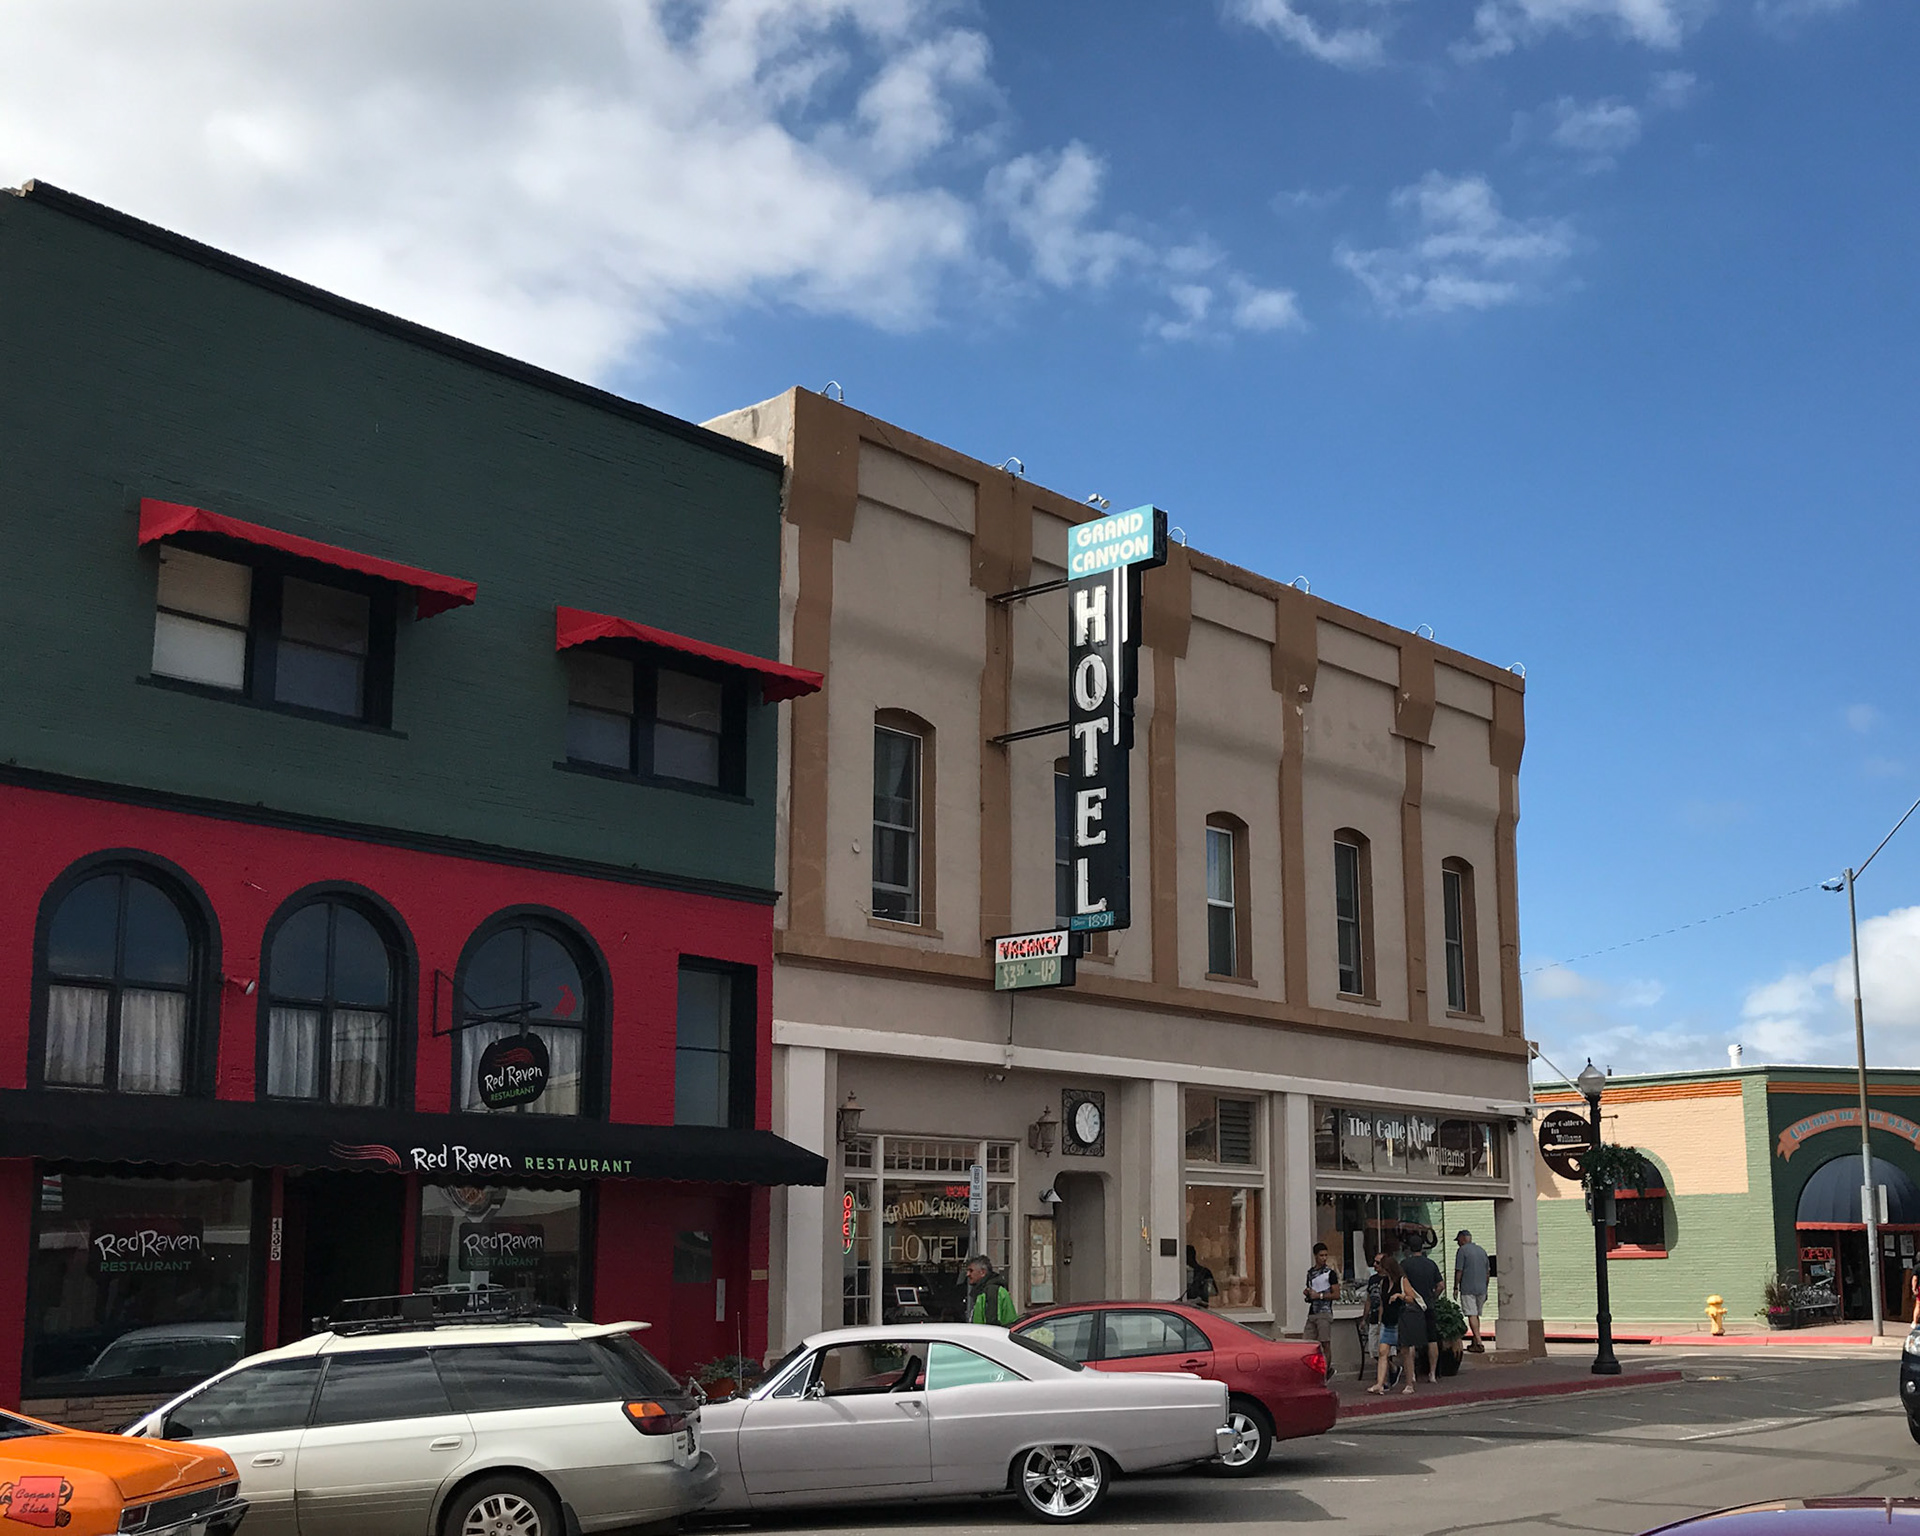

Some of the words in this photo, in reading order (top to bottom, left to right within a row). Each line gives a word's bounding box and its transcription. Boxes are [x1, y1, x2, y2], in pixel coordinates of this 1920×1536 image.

[1076, 512, 1144, 548] GRAND
[1071, 534, 1149, 573] CANYON
[1074, 584, 1109, 914] HOTEL
[1088, 912, 1112, 927] 1891
[484, 1066, 505, 1092] Red
[506, 1065, 543, 1087] Raven
[490, 1085, 536, 1101] RESTAURANT
[1348, 1117, 1372, 1137] The
[1789, 1111, 1837, 1140] COLORS
[1838, 1110, 1856, 1121] OF
[1887, 1115, 1920, 1140] WEST
[410, 1143, 448, 1171] Red
[451, 1145, 513, 1173] Raven
[524, 1156, 633, 1173] RESTAURANT
[1426, 1146, 1466, 1168] Williams
[884, 1199, 926, 1224] GRAND
[94, 1230, 138, 1261] Red
[138, 1230, 201, 1258] Raven
[271, 1218, 282, 1260] 135
[463, 1232, 498, 1257] Red
[497, 1232, 543, 1257] Raven
[888, 1234, 968, 1261] HOTEL
[100, 1260, 192, 1272] RESTAURANT
[466, 1257, 541, 1267] RESTAURANT
[1801, 1247, 1832, 1260] OPEN
[15, 1489, 56, 1503] Copper
[19, 1503, 49, 1515] State
